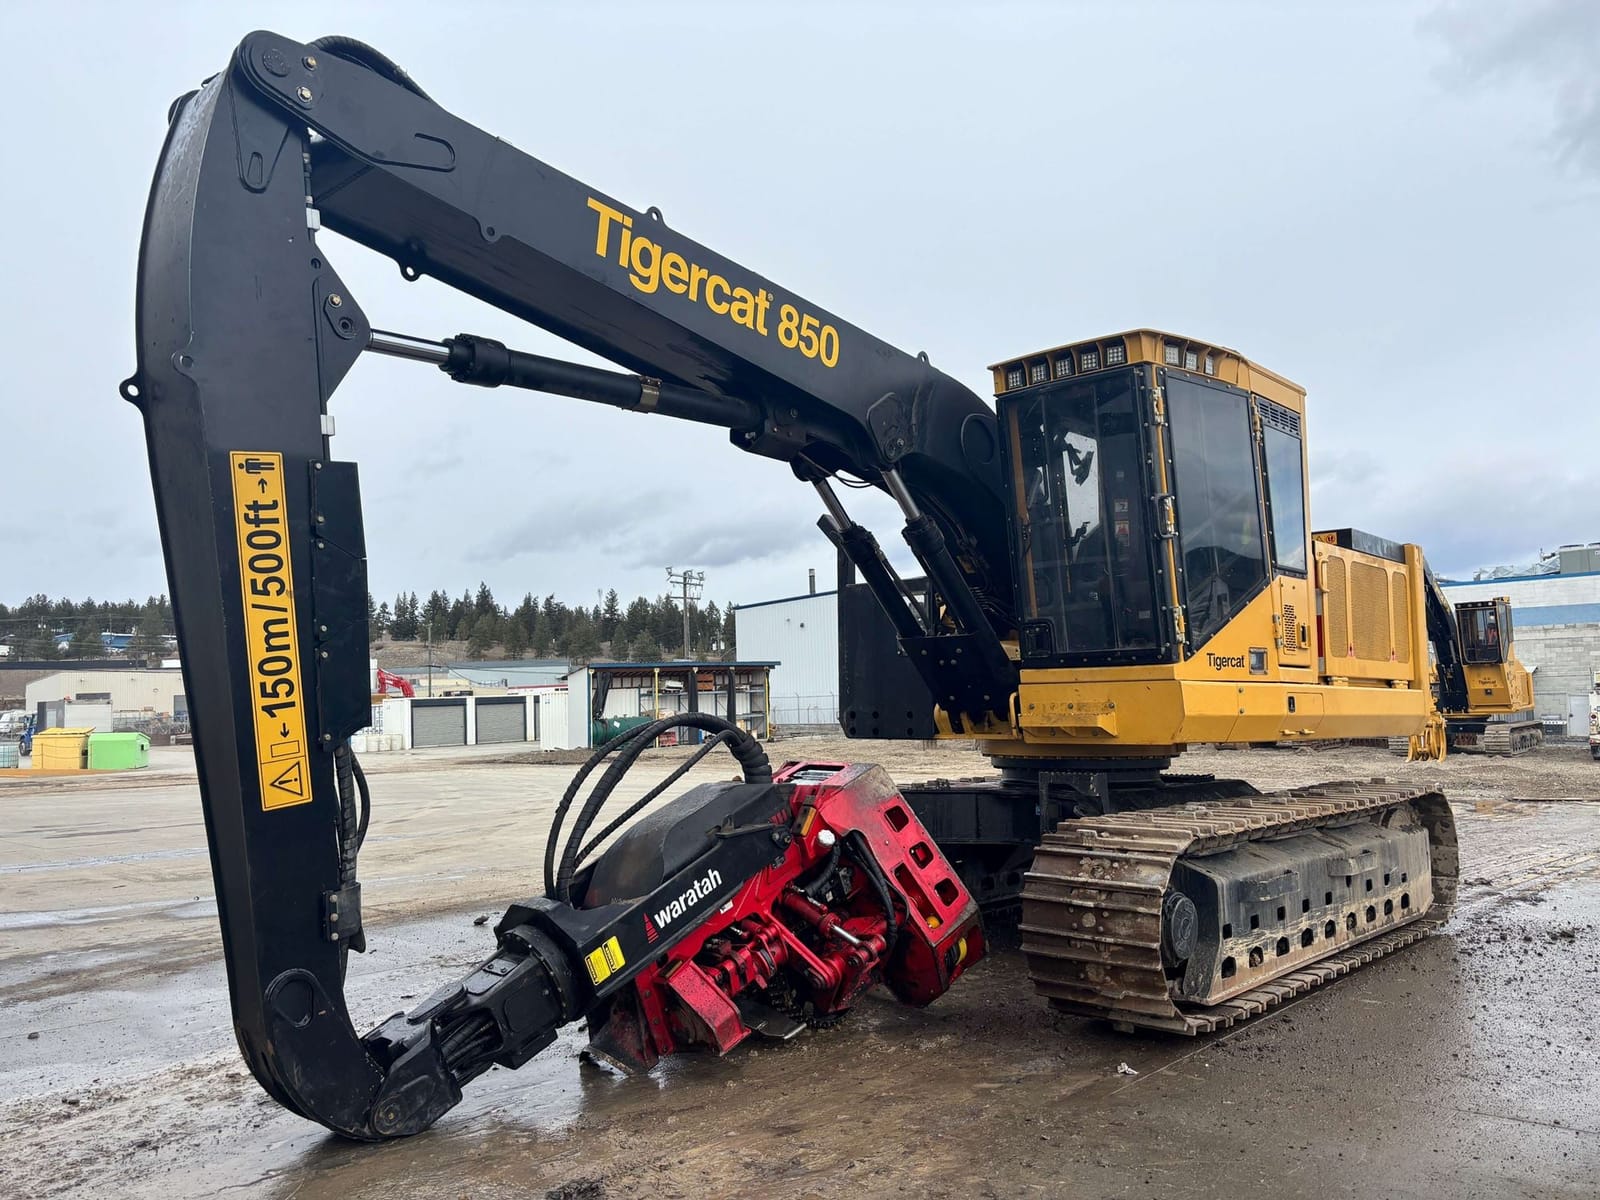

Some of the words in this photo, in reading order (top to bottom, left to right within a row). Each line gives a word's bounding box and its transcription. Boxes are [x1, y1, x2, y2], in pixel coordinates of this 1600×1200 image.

[587, 196, 769, 336] Tigercat
[777, 304, 839, 368] 850
[243, 499, 297, 719] 150m/500ft
[1206, 653, 1245, 671] Tigercat
[654, 868, 722, 928] waratah
